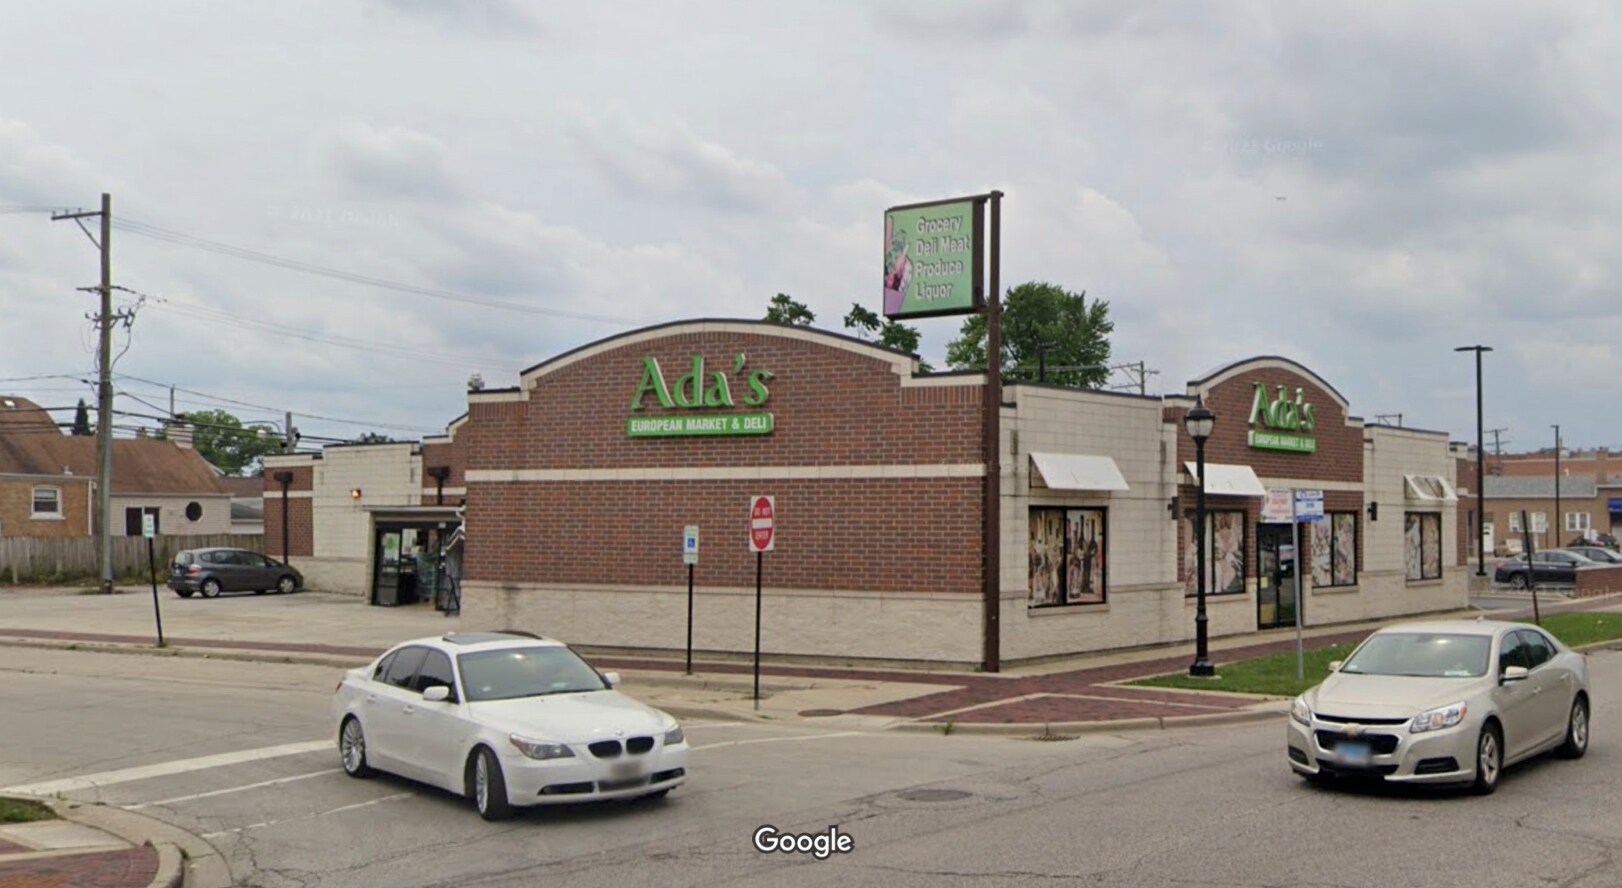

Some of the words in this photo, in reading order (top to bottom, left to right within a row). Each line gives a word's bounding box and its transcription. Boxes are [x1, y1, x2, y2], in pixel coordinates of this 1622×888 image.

[916, 215, 962, 233] Grocery
[916, 238, 938, 255] Deli
[941, 235, 969, 253] Meat
[916, 259, 963, 278] Produce
[916, 281, 953, 301] Liquor
[630, 353, 774, 409] Ada's
[1248, 381, 1315, 430] Ada's
[631, 419, 683, 432] EUROPEAN
[686, 418, 727, 430] MARKET
[731, 417, 739, 430] &
[743, 417, 767, 430] DELI
[1255, 433, 1279, 445] EUROPEAN
